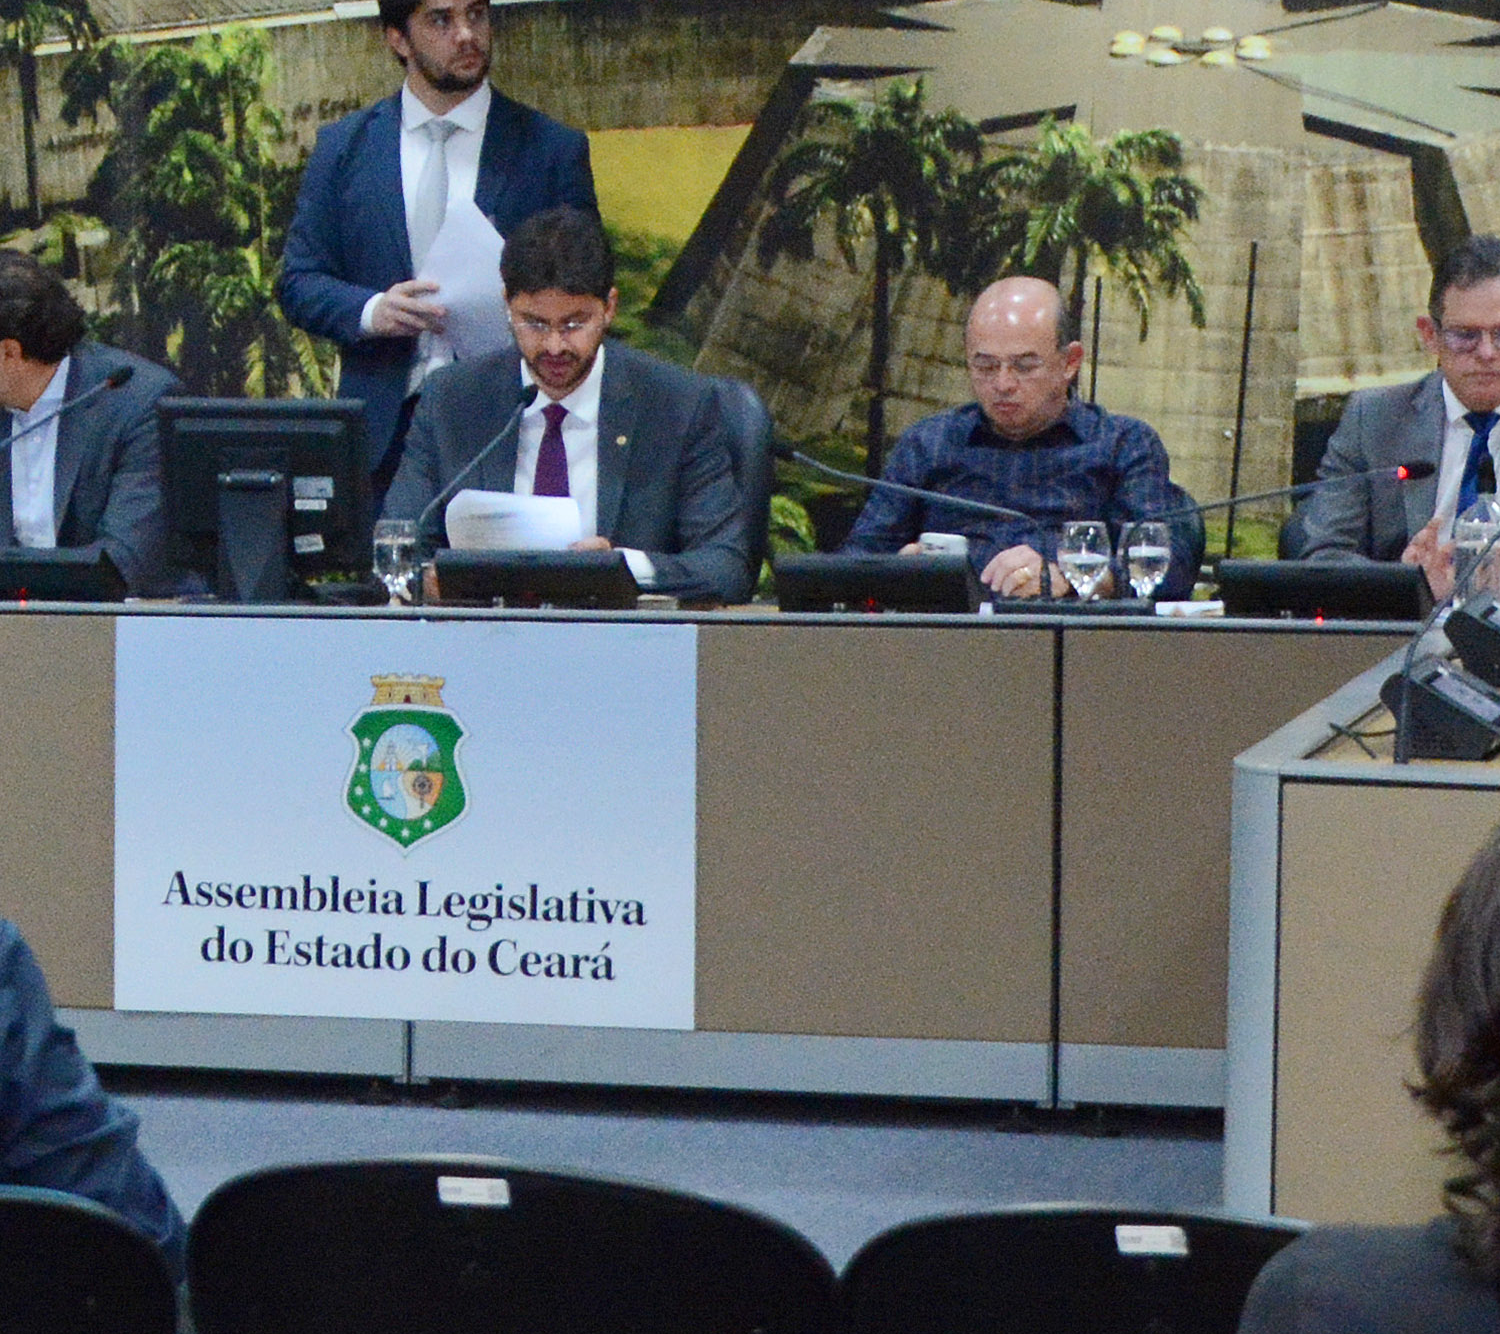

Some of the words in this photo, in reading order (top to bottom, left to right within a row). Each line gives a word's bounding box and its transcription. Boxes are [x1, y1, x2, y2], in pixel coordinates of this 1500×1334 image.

[162, 870, 405, 917] Assembleia
[416, 880, 648, 932] Legislativa
[200, 925, 254, 964] do
[265, 929, 411, 972] Estado
[421, 935, 477, 974] do
[488, 939, 616, 981] Ceará
